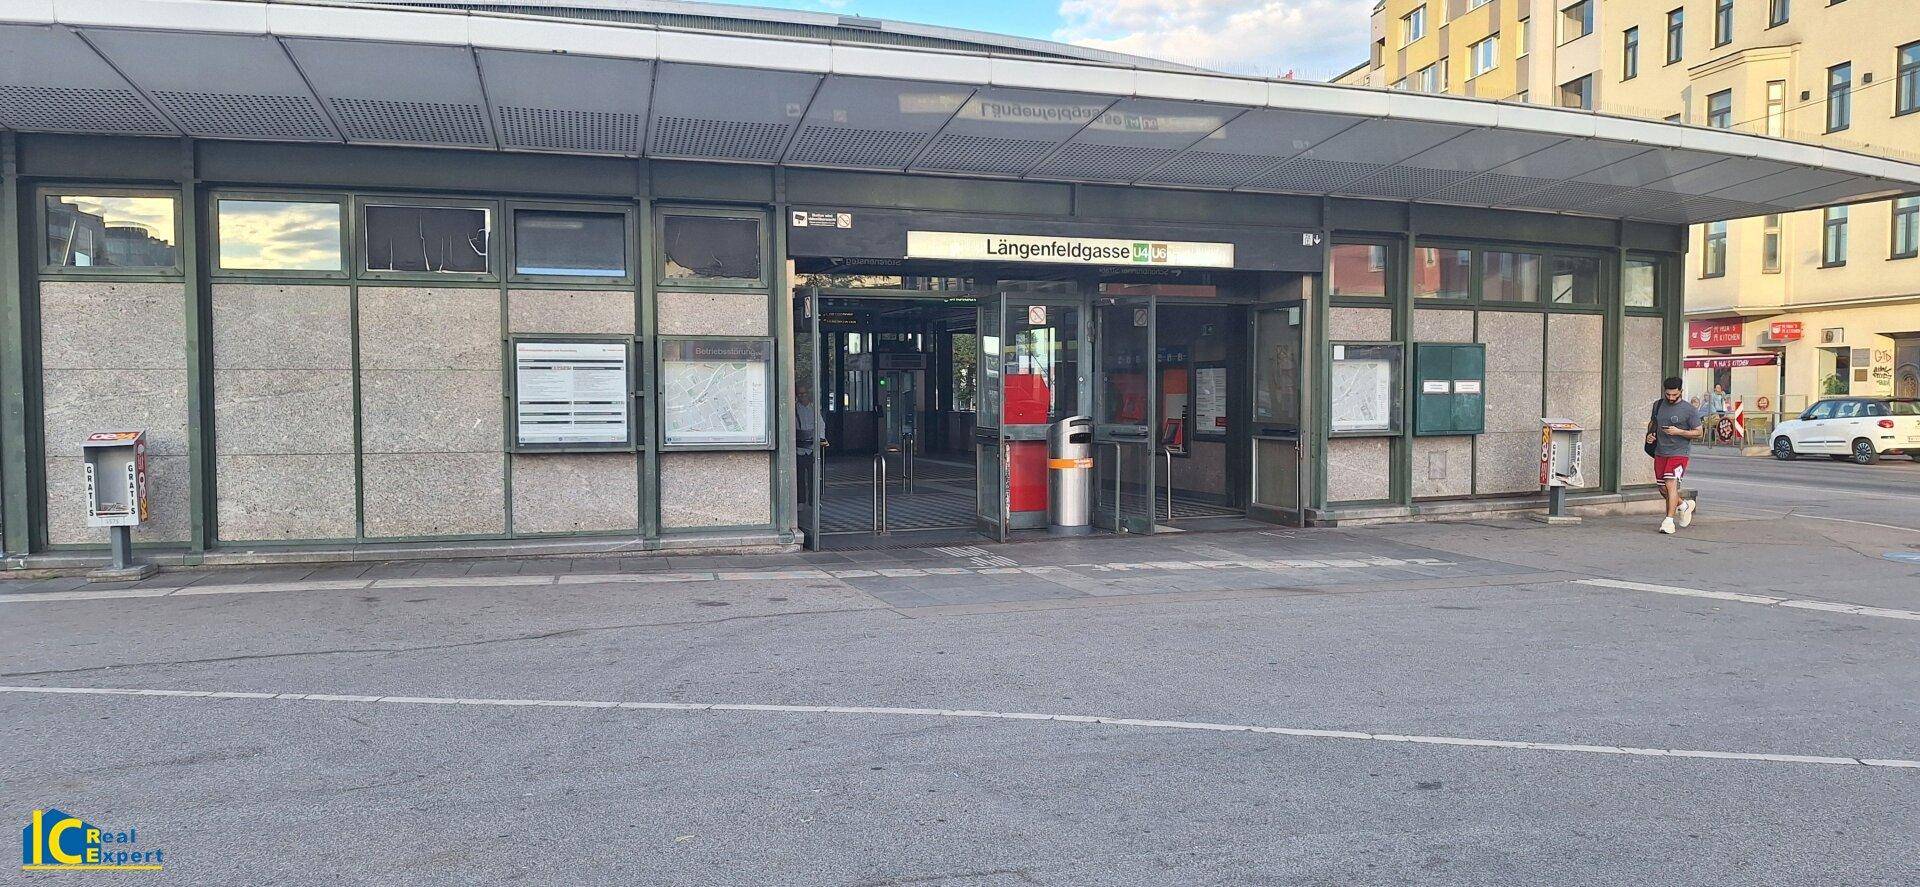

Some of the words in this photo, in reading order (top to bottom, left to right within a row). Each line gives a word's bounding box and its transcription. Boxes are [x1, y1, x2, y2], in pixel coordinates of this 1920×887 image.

[986, 238, 1130, 261] Längenfeldgasse
[1133, 245, 1149, 260] U4
[1152, 246, 1167, 260] U6
[86, 467, 94, 517] GRATIS
[127, 465, 136, 515] GRATIS
